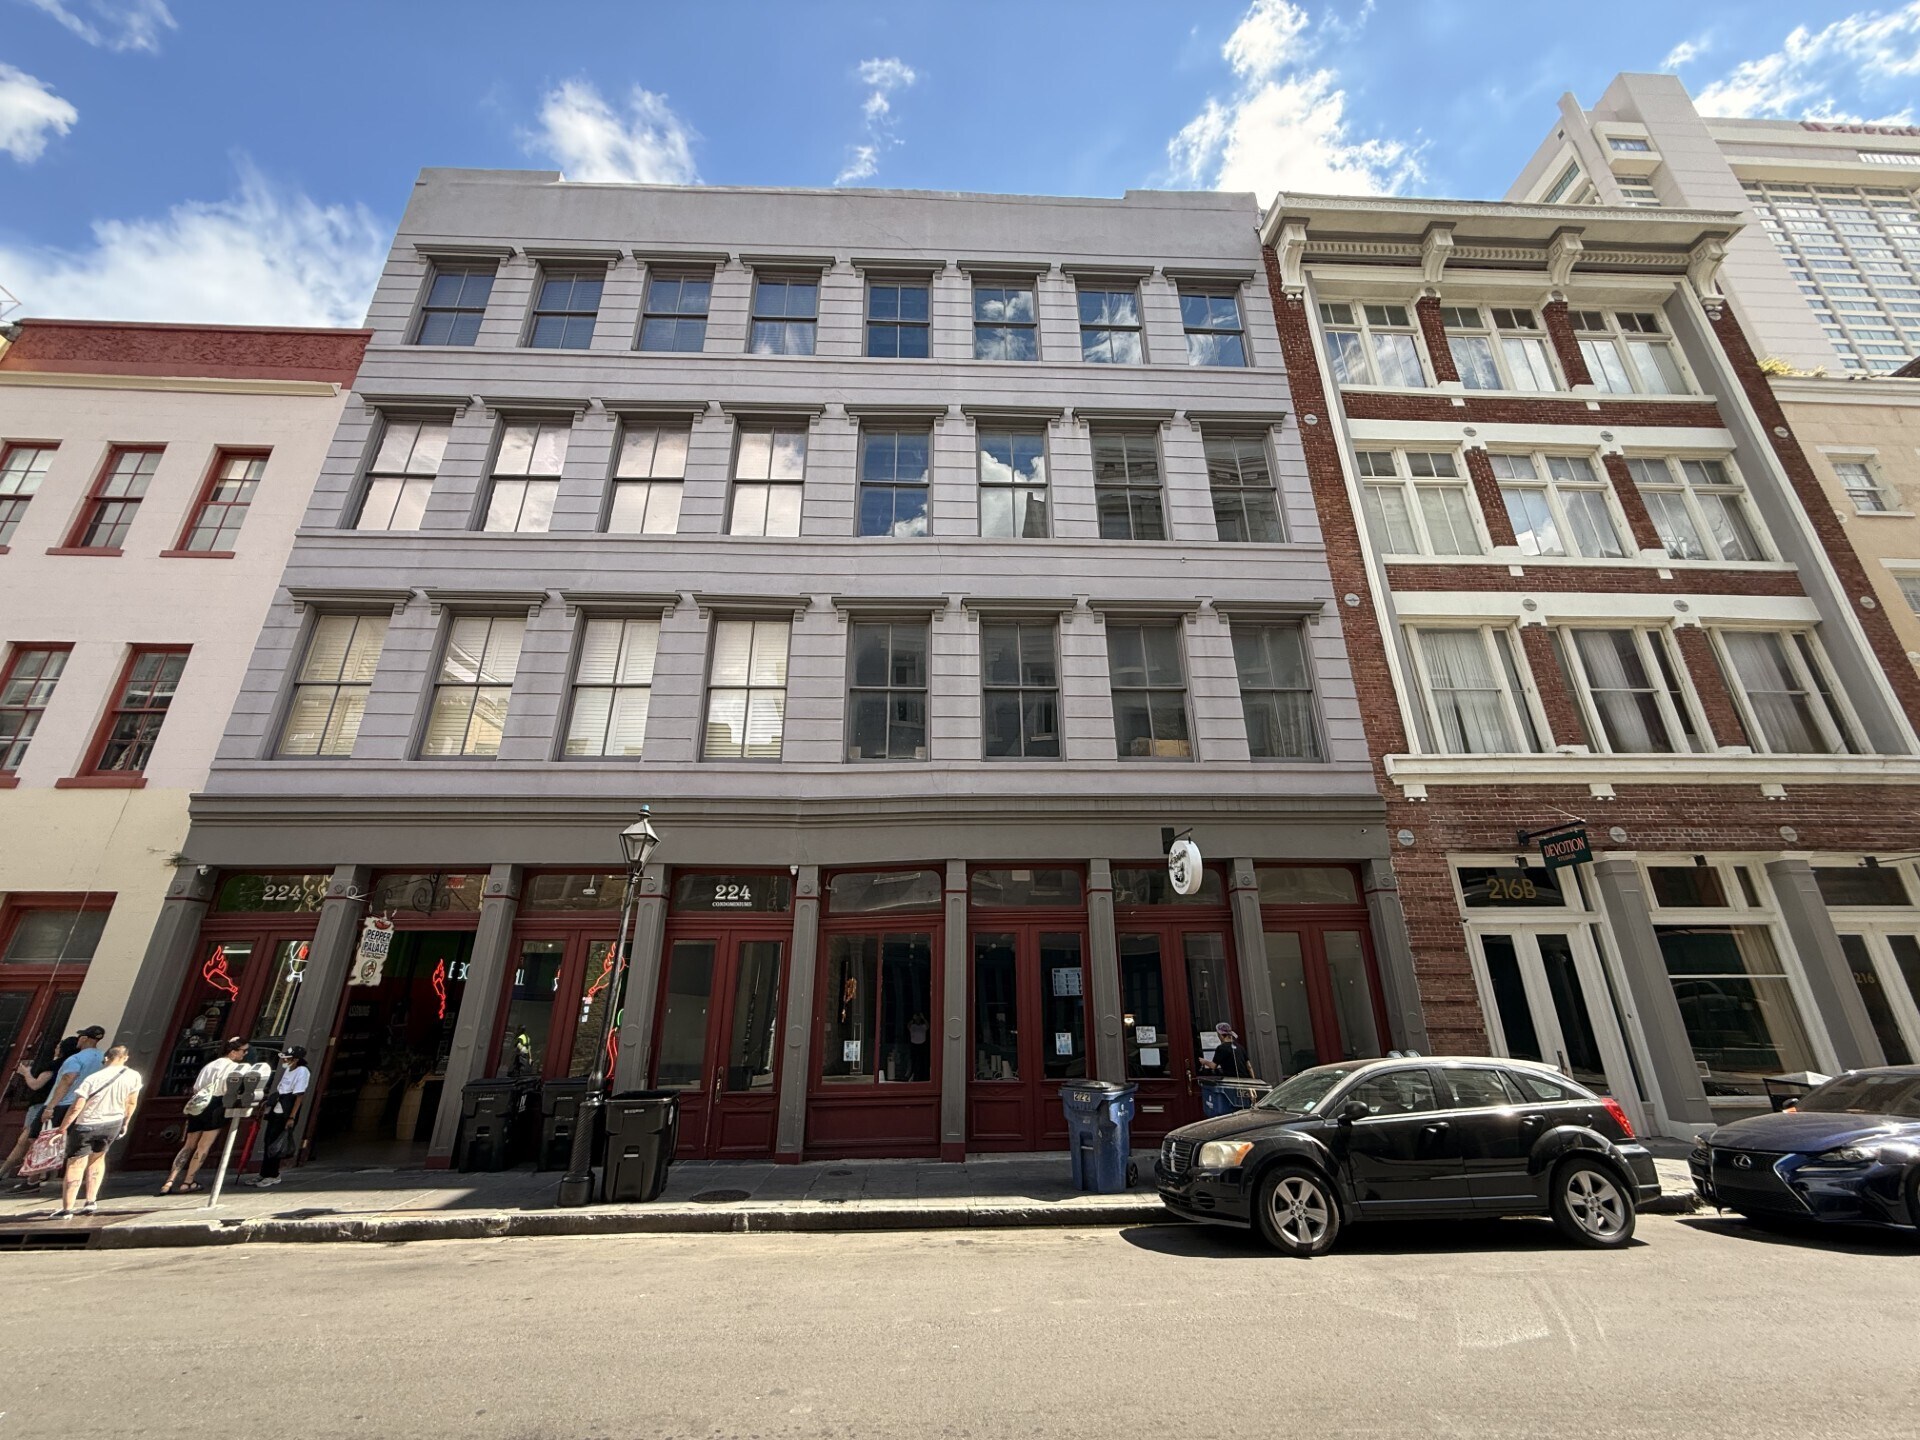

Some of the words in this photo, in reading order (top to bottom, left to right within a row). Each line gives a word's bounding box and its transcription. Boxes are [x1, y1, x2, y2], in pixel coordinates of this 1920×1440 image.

[1544, 837, 1585, 857] DEVOTION
[262, 885, 301, 901] 224
[714, 884, 752, 900] 224
[1486, 877, 1536, 899] 216B
[367, 928, 391, 942] PEPPER
[364, 941, 388, 953] PALACE
[1853, 971, 1876, 984] 216
